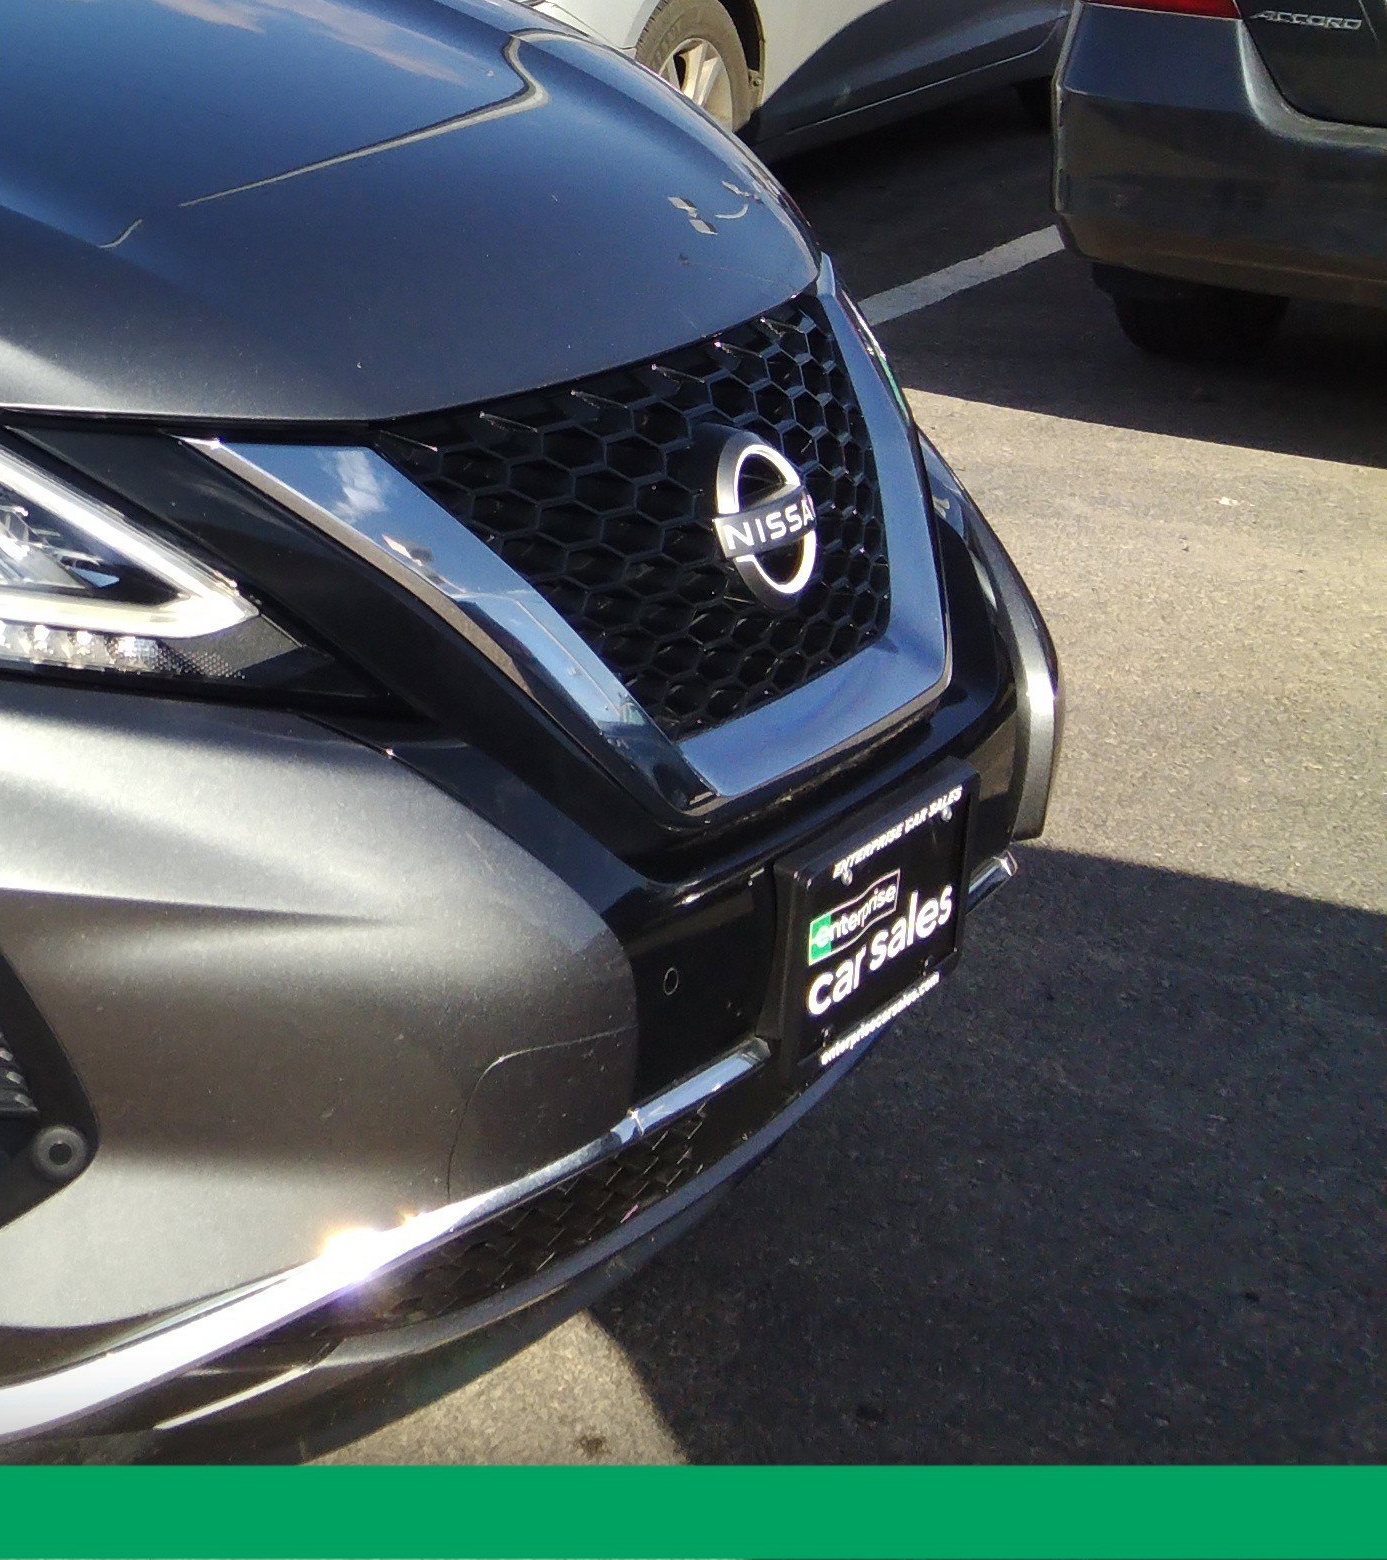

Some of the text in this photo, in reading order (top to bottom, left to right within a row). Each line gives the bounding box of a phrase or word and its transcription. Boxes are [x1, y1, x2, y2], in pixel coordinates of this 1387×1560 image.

[1249, 8, 1363, 30] ACCORD
[832, 784, 963, 879] ENTERPRISE CAR SALES
[807, 883, 953, 1015] car sales
[815, 883, 897, 948] enterprise
